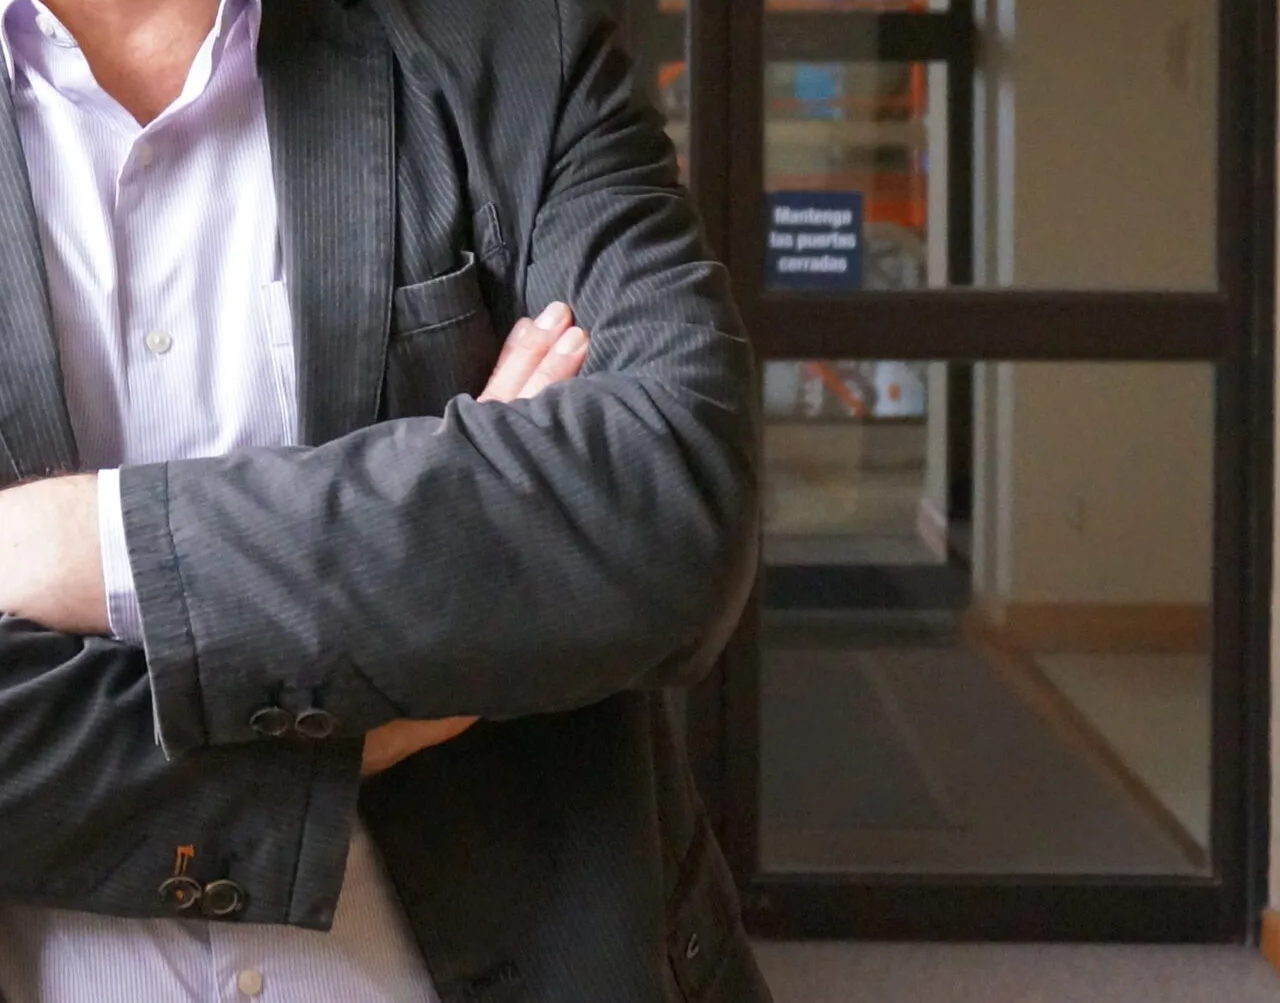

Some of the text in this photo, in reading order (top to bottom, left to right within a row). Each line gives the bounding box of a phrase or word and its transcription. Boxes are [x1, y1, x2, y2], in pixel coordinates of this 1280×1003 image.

[769, 230, 857, 252] las puertas
[778, 254, 847, 273] cerradas
